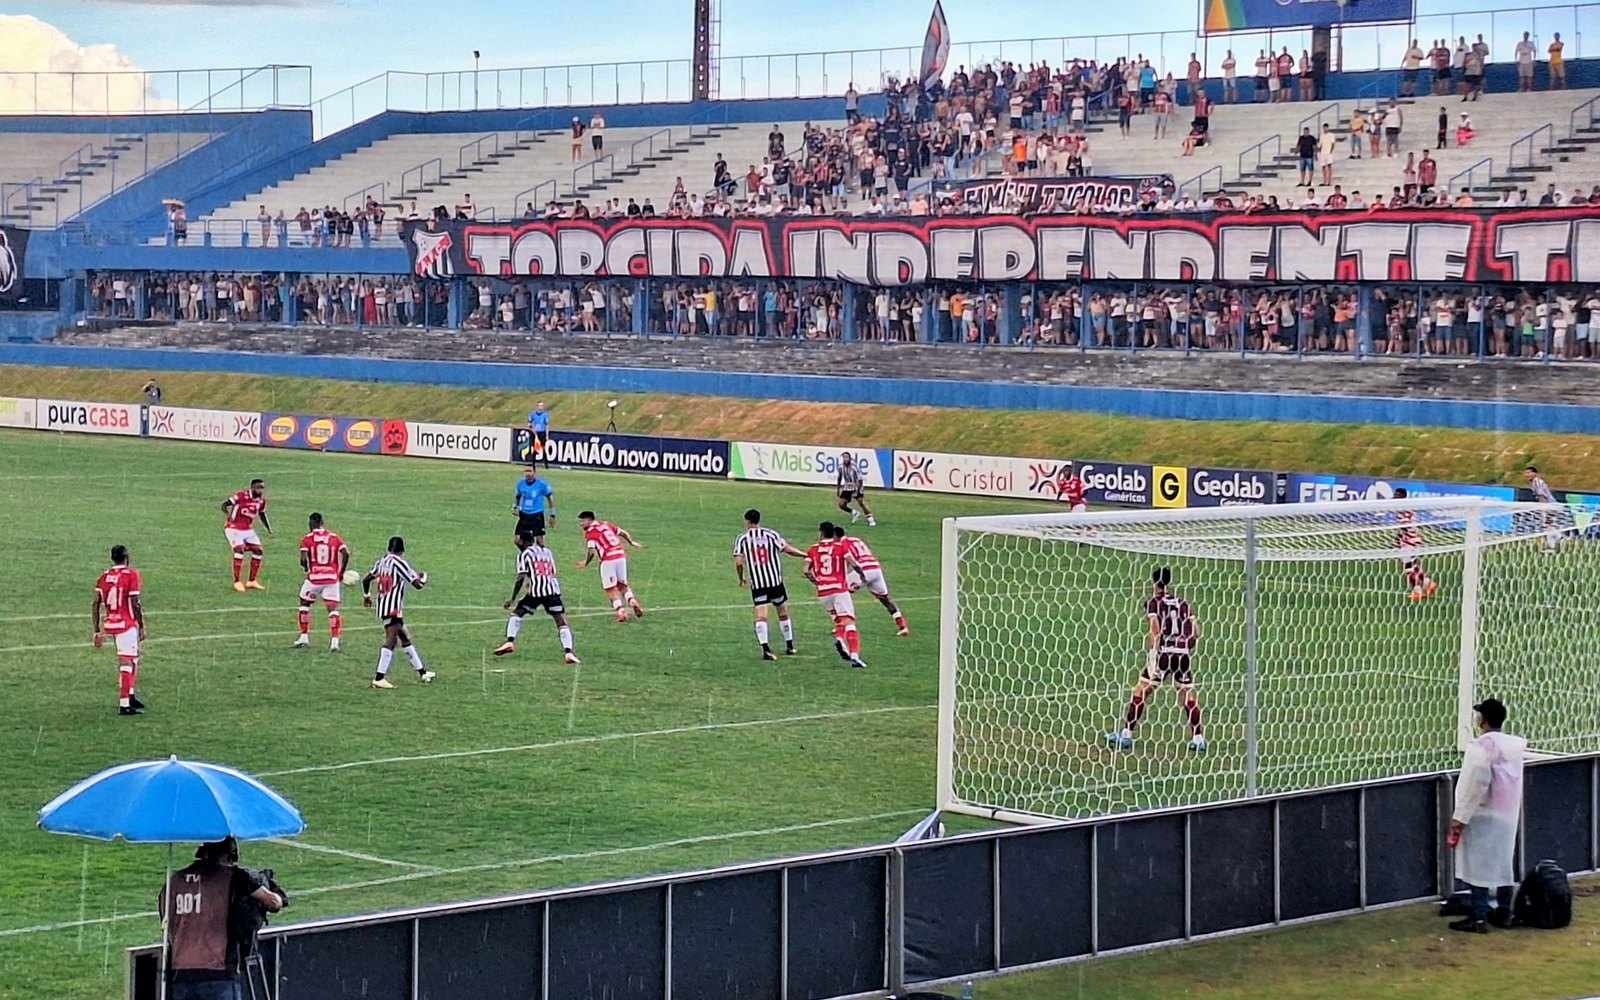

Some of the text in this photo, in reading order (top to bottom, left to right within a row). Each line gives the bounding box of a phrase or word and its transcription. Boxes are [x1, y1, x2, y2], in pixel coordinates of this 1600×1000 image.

[469, 228, 776, 277] TORCIDA
[183, 419, 225, 438] Cristal
[416, 425, 498, 454] Imperador
[617, 448, 659, 469] novo
[662, 450, 724, 473] mundo
[771, 449, 812, 472] Mais
[948, 468, 1013, 491] Cristal
[1080, 464, 1146, 491] Geolab
[1159, 472, 1180, 501] G
[1193, 471, 1265, 499] Geolab
[819, 555, 832, 576] 3
[106, 586, 118, 611] 4
[175, 892, 202, 915] 901
